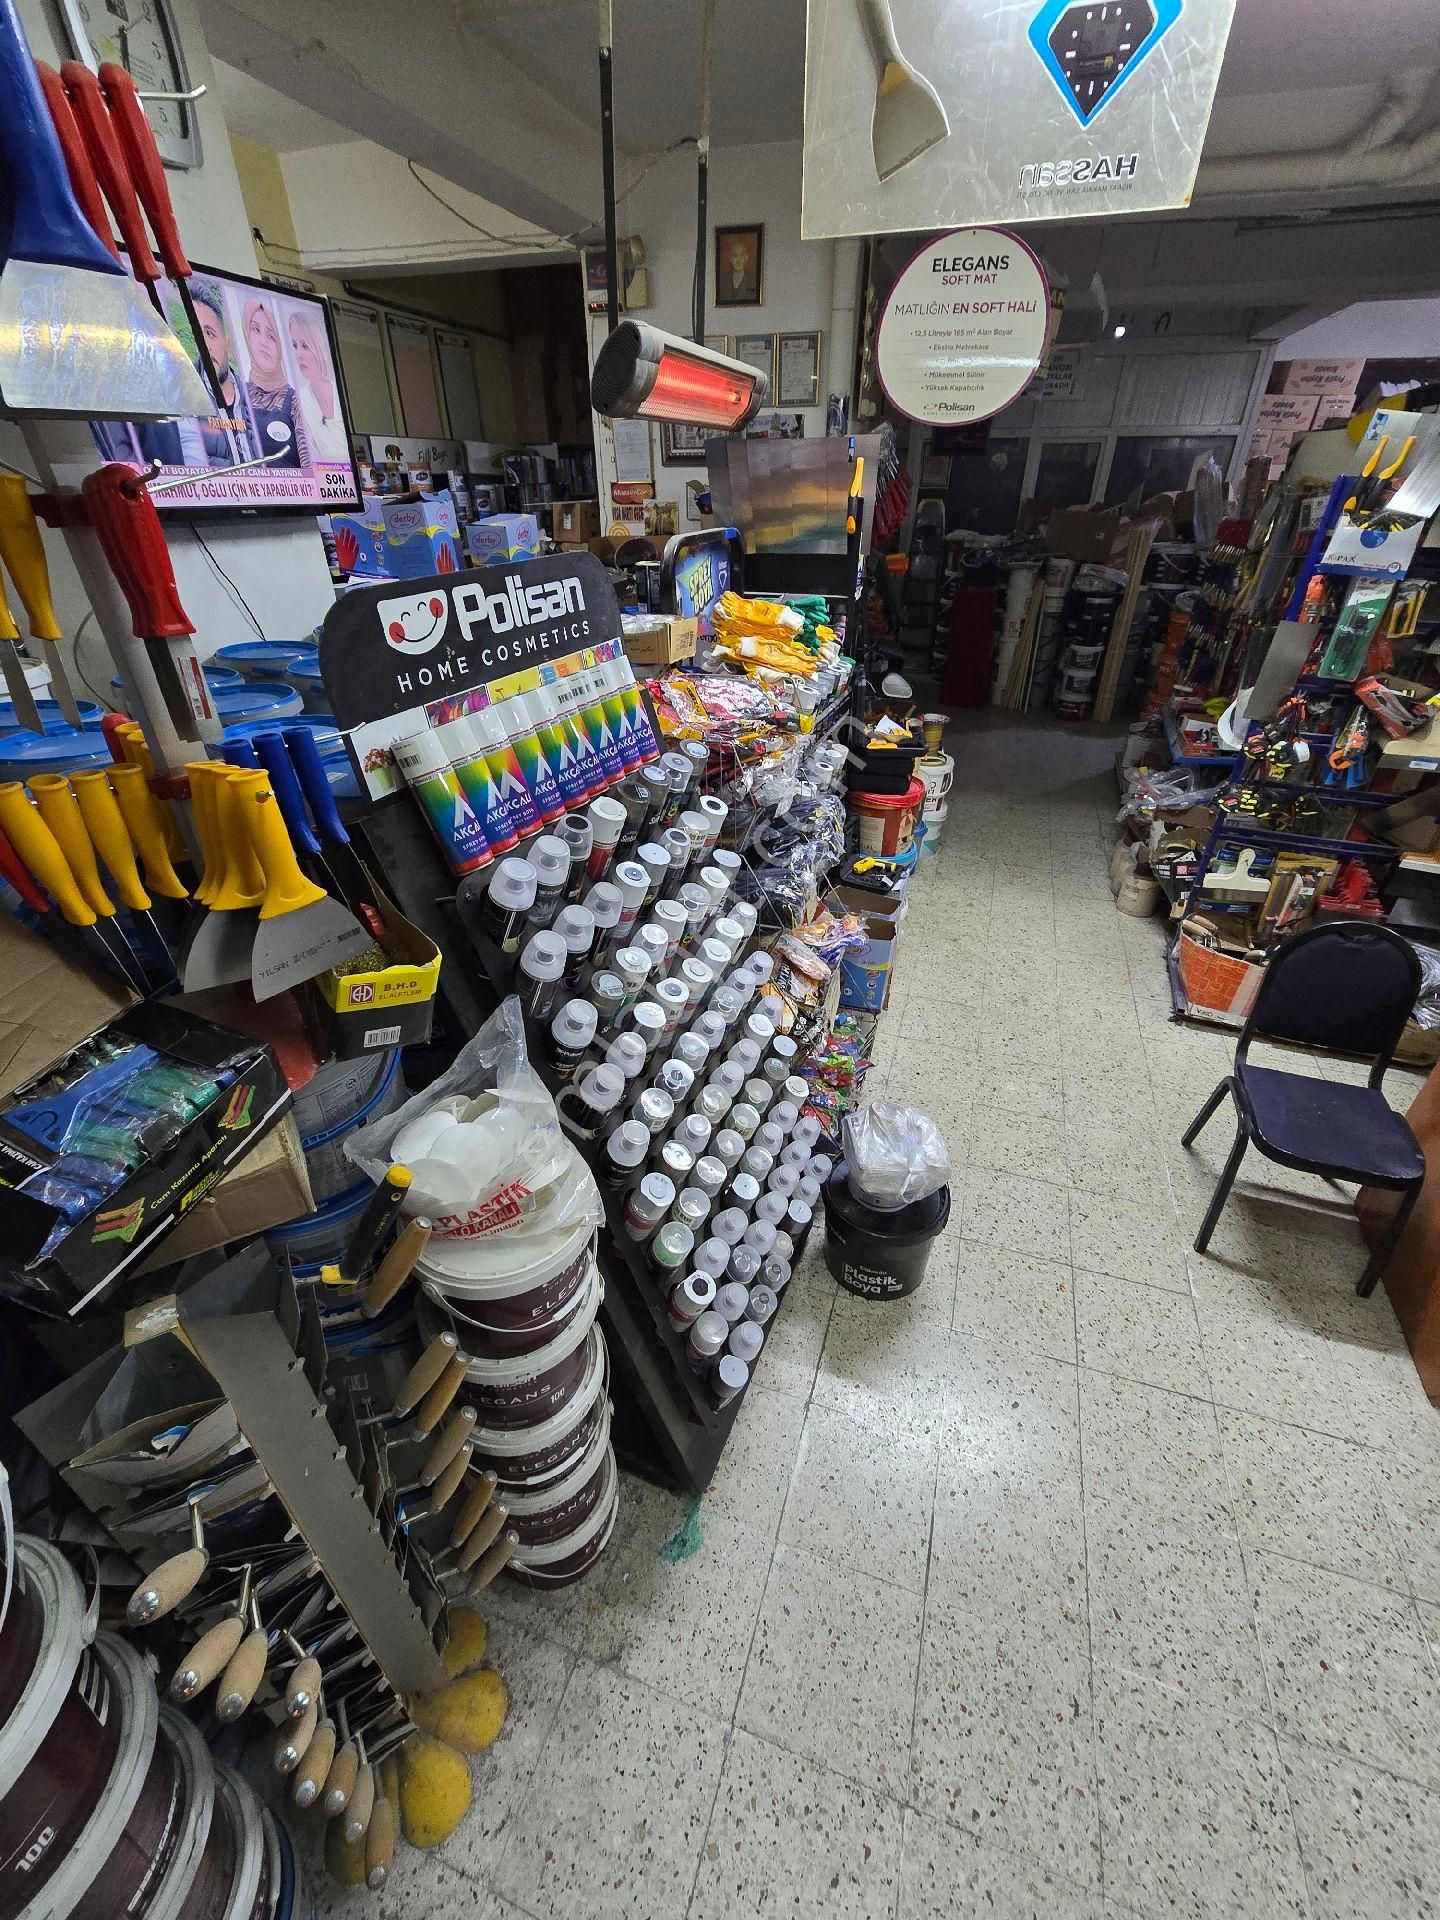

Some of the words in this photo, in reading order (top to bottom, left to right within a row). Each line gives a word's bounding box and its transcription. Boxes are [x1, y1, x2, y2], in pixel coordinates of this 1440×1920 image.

[931, 255, 1010, 273] ELEGANS
[941, 274, 971, 286] SOFT
[973, 273, 998, 284] MAT
[894, 301, 950, 316] MATLIĞIN
[952, 302, 969, 314] EN
[972, 302, 1005, 313] SOFT
[1007, 300, 1038, 313] HALİ
[938, 402, 976, 412] Polisan
[272, 469, 303, 477] YAYINDA
[325, 473, 346, 484] SON
[201, 480, 226, 498] OĞLU
[227, 480, 248, 501] İÇİN
[249, 484, 261, 497] NE
[261, 480, 299, 497] YAPABİLİR
[320, 485, 356, 499] DAKİKA
[394, 511, 416, 524] derby
[475, 536, 497, 546] derby
[451, 574, 586, 642] Polisan
[396, 657, 470, 694] HOME
[481, 619, 591, 667] COSMETICS
[150, 1190, 171, 1209] Cam
[844, 1272, 882, 1294] Boya
[845, 1262, 897, 1286] Plastik
[550, 1386, 566, 1404] 100
[507, 1424, 588, 1473] ELEGANS
[14, 1825, 54, 1873] 100
